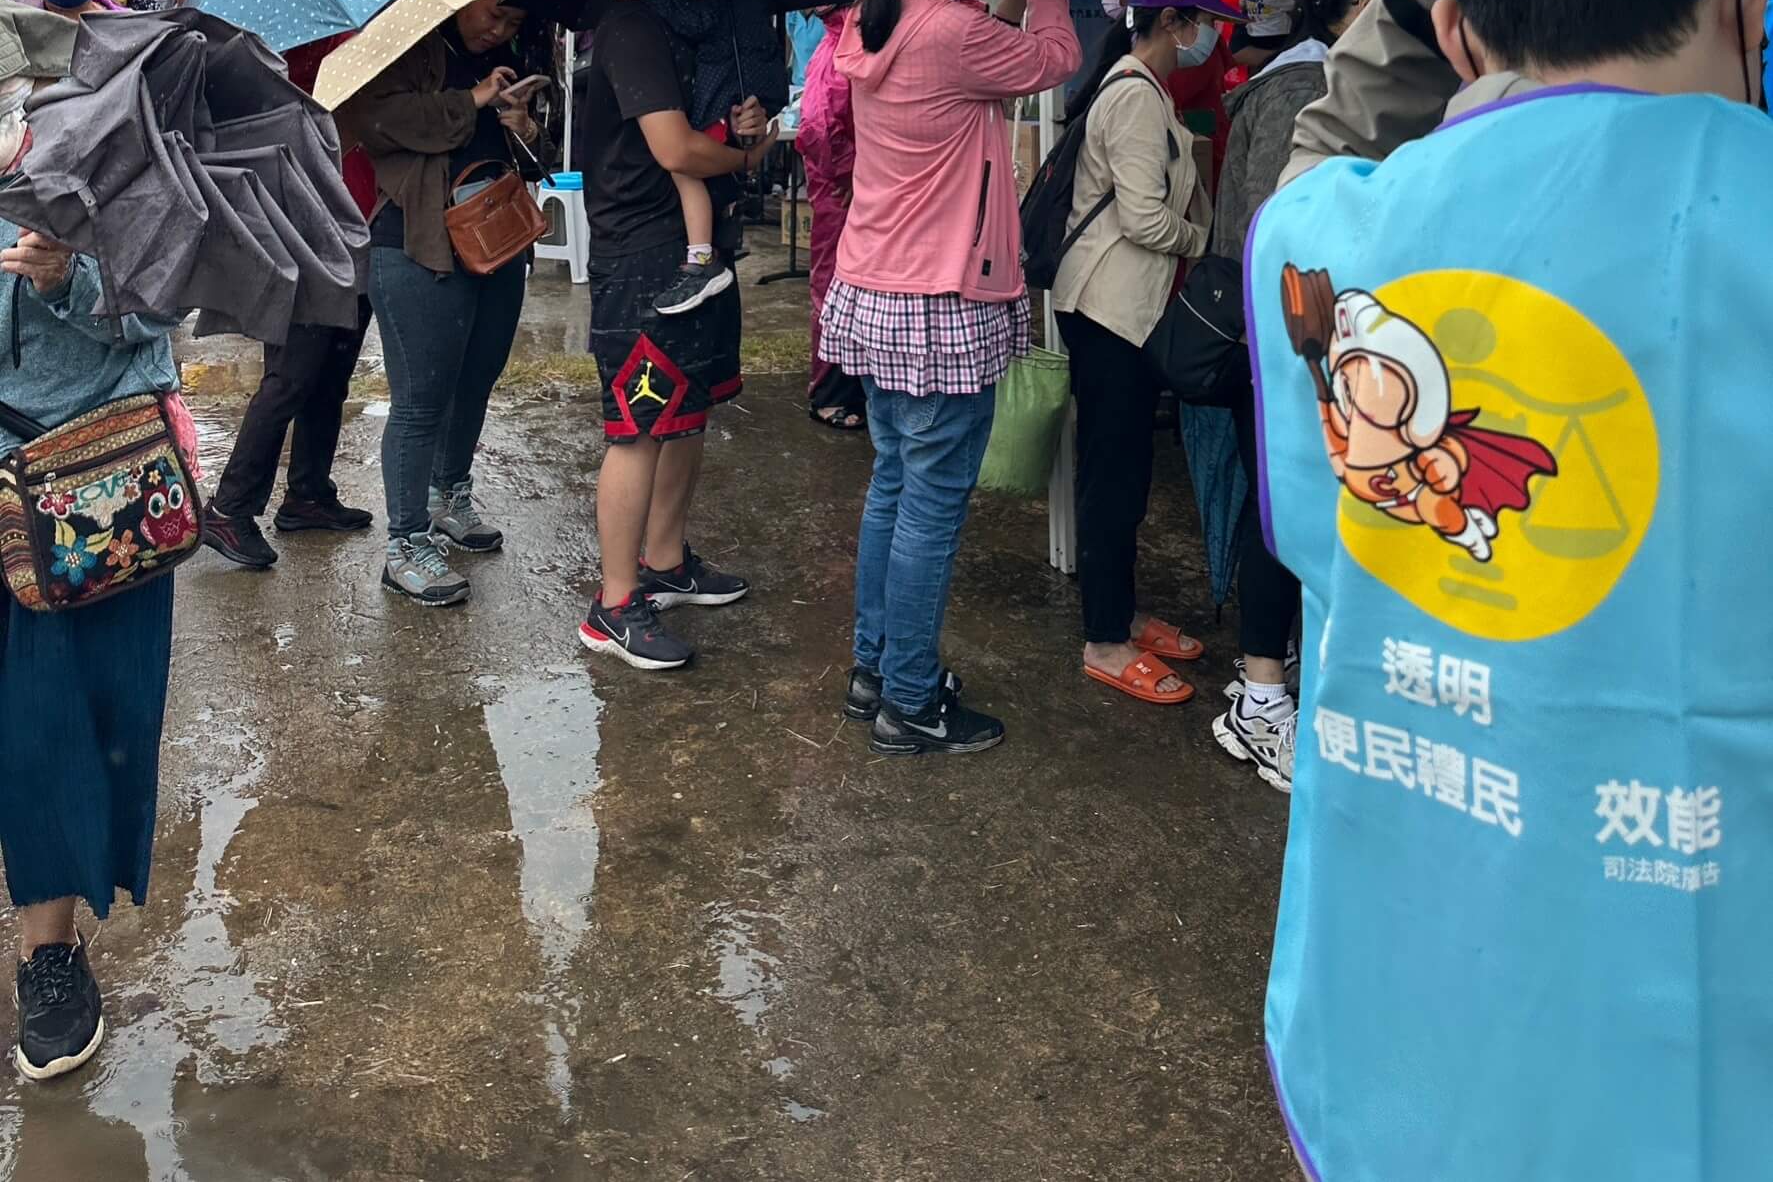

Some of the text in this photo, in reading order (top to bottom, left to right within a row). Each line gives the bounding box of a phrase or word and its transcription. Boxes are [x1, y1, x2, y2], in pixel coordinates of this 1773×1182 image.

[1382, 637, 1493, 726] 透明
[1313, 705, 1523, 838] 便民禮民
[1594, 779, 1722, 856] 效能
[1602, 855, 1721, 892] 司法院廣告
